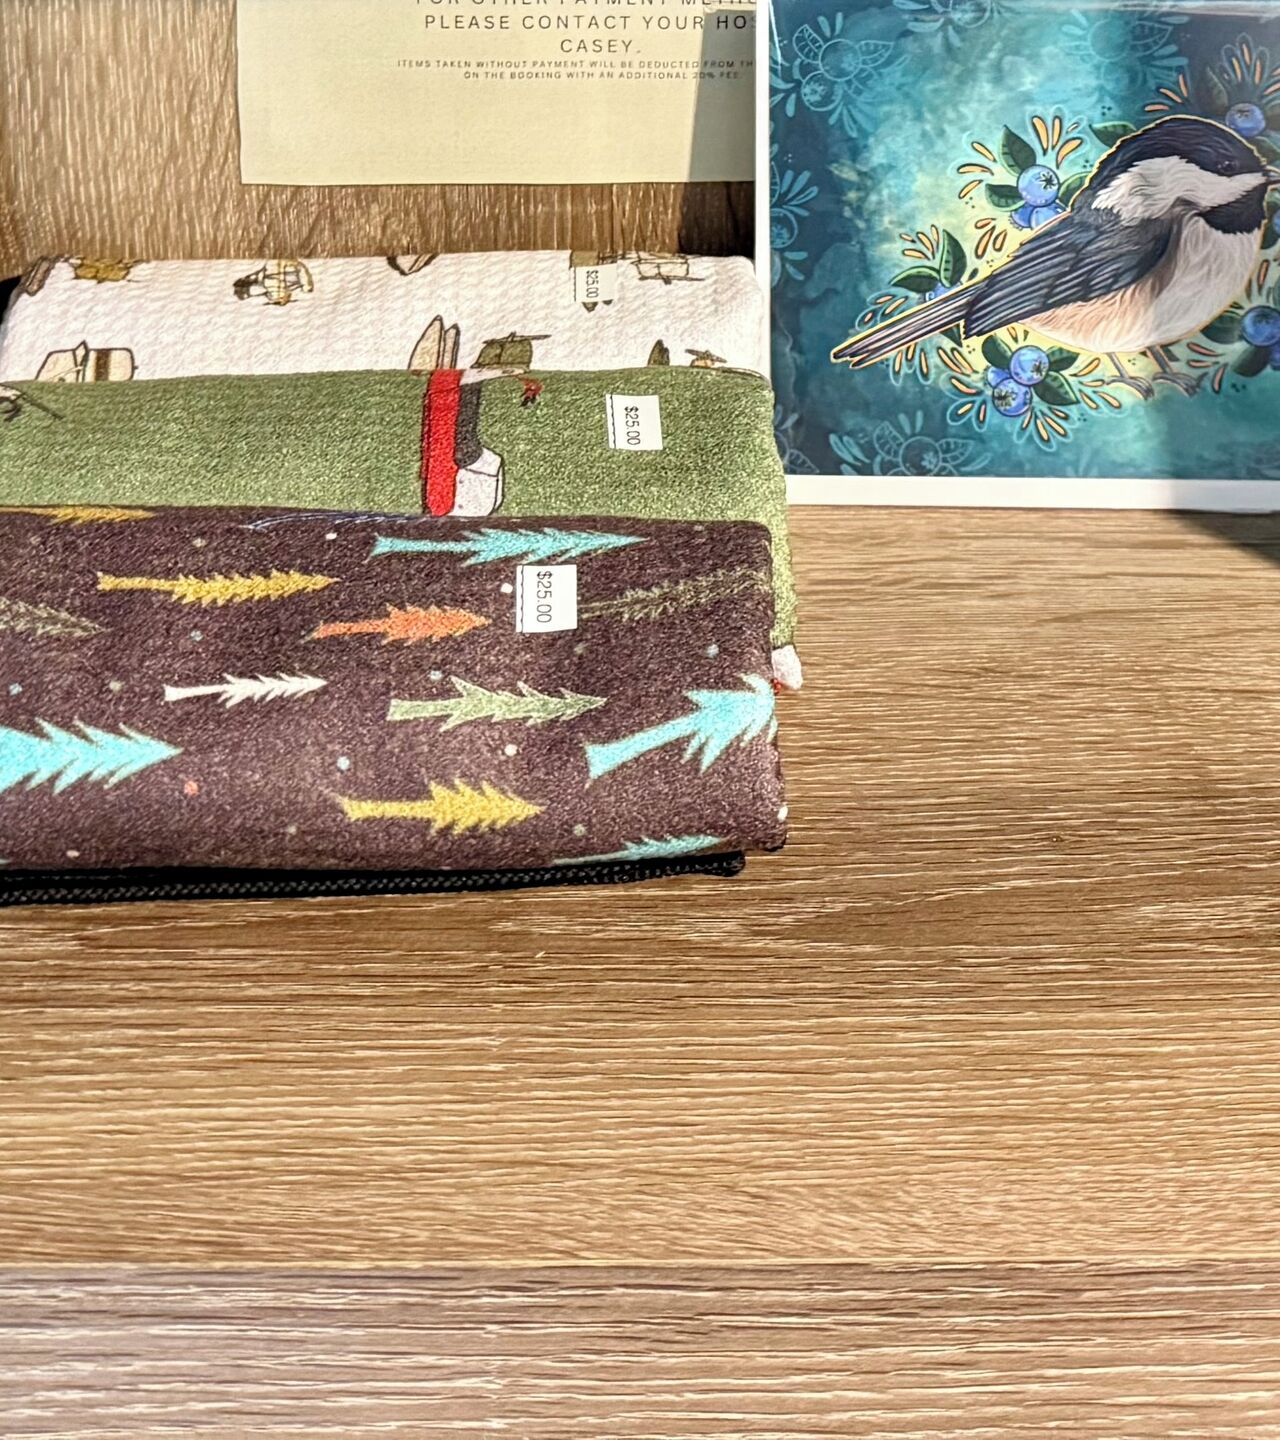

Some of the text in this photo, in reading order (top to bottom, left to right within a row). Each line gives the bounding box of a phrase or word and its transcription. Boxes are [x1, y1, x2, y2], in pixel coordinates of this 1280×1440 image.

[425, 15, 756, 30] PLEASE CONTACT YOUR HO
[560, 39, 641, 53] CASEY.
[397, 60, 431, 68] ITEMS
[436, 60, 471, 68] TAKEN
[476, 60, 527, 68] WITHOUT
[532, 60, 584, 68] PAYMENT
[589, 60, 616, 68] WILL
[639, 61, 699, 69] DEDUCTED
[464, 71, 479, 79] ON
[485, 71, 505, 79] THE
[566, 71, 594, 79] WITH
[599, 71, 614, 79] AN
[619, 71, 688, 79] ADDITIONAL
[585, 270, 599, 298] $25.00
[623, 406, 641, 446] $25.00
[536, 571, 553, 624] $25.00
